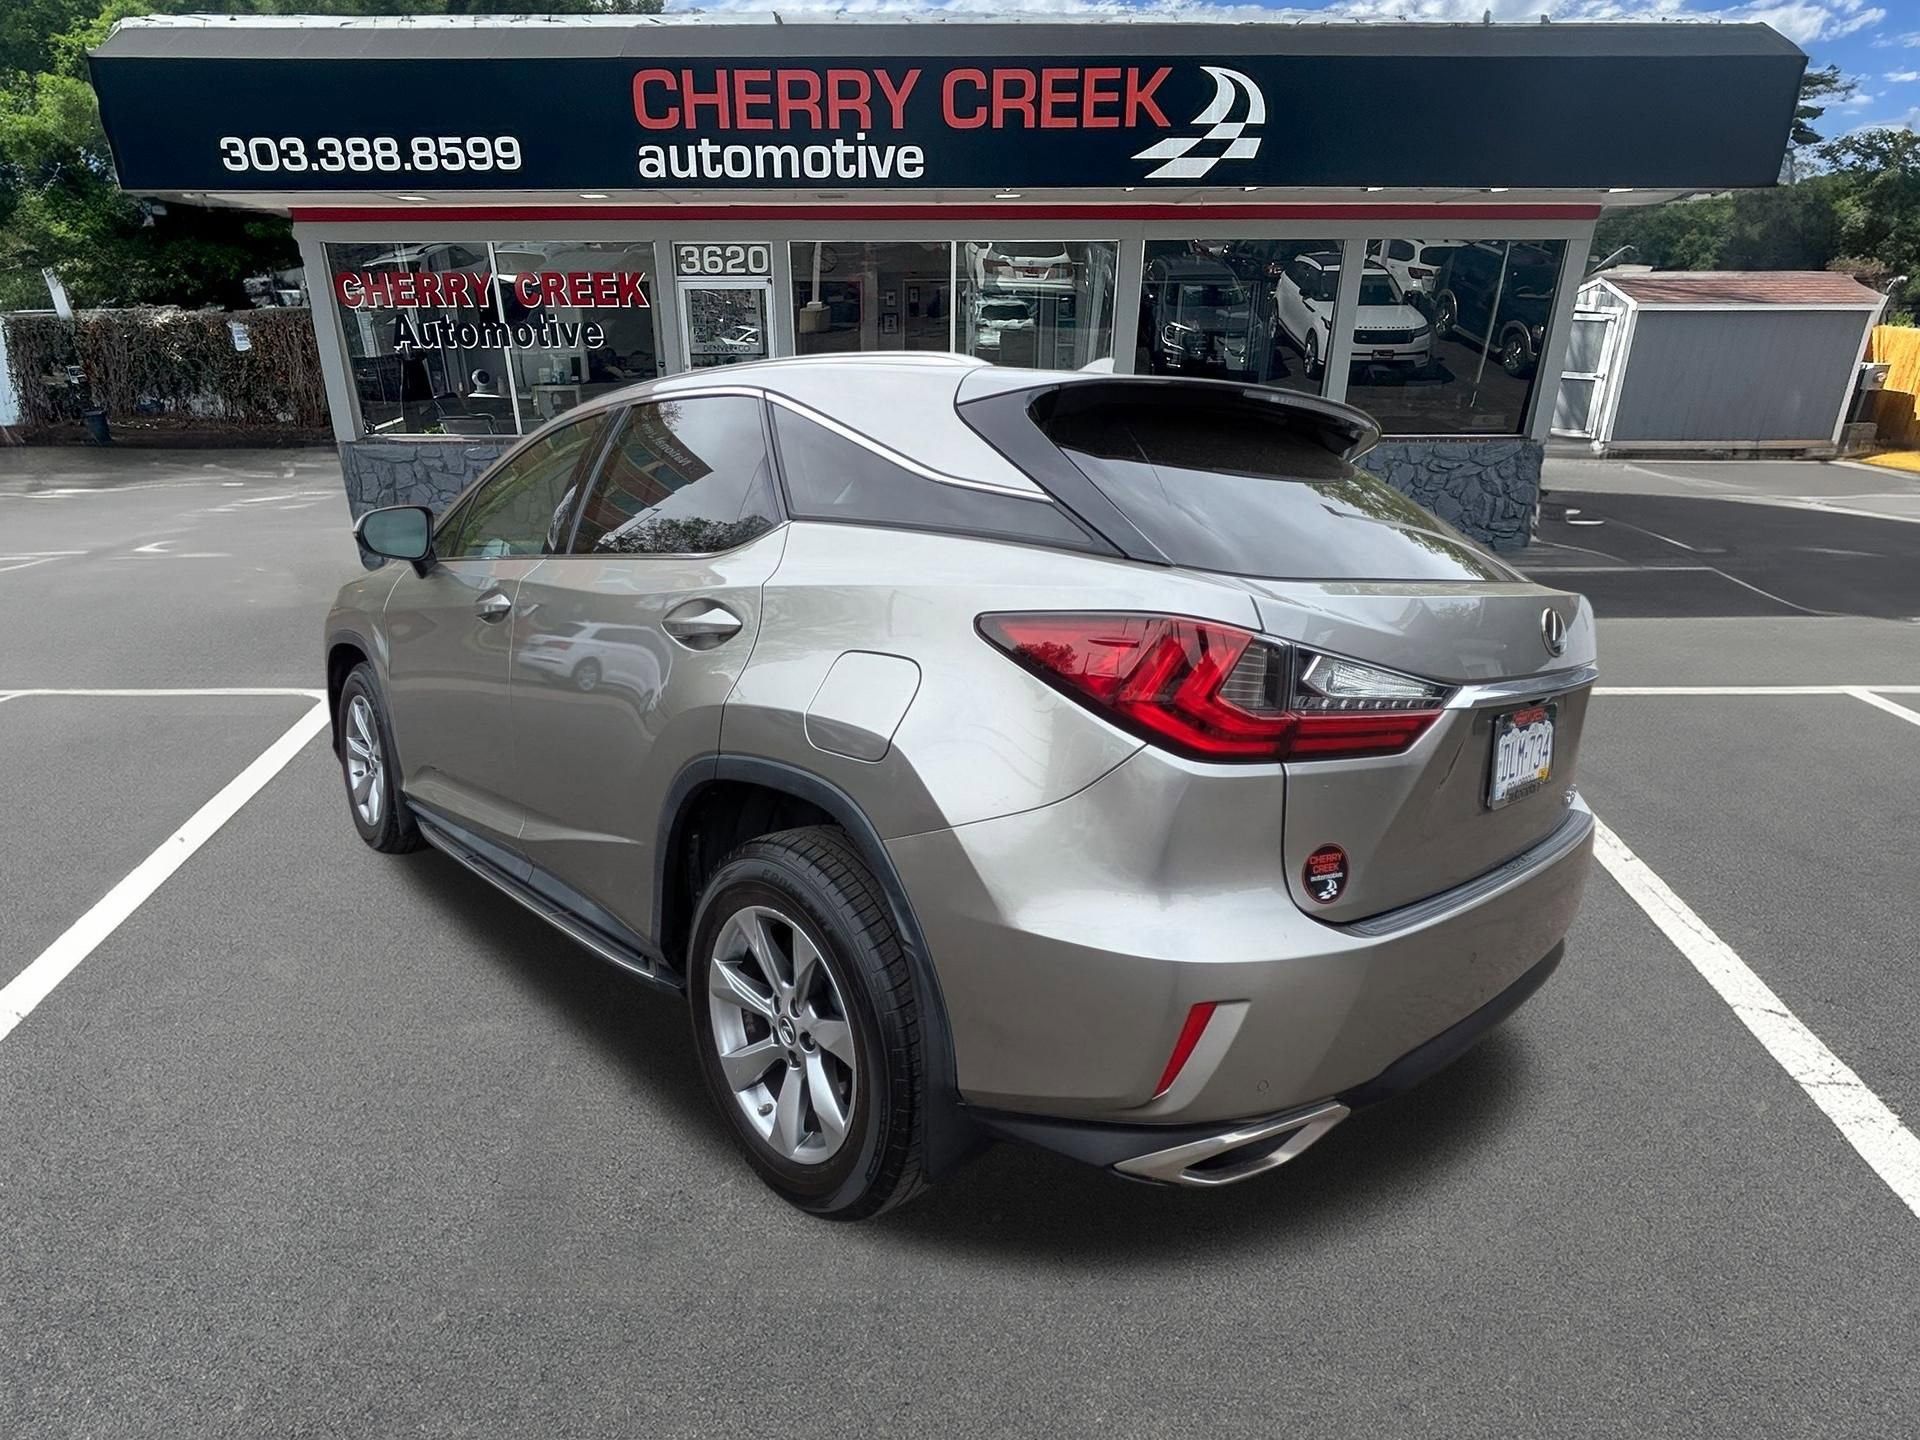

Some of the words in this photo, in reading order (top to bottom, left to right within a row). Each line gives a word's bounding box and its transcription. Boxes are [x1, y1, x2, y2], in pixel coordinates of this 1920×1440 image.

[632, 68, 921, 130] CHERRY
[942, 67, 1173, 129] CREEK
[220, 136, 522, 171] 303.388.8599
[638, 132, 924, 179] automotive
[680, 246, 769, 273] 3620
[334, 271, 495, 308] CHERRY
[514, 271, 650, 308] CREEK
[392, 313, 605, 350] Automotive
[1310, 853, 1343, 865] CHERRY
[1312, 862, 1340, 874] CREEK
